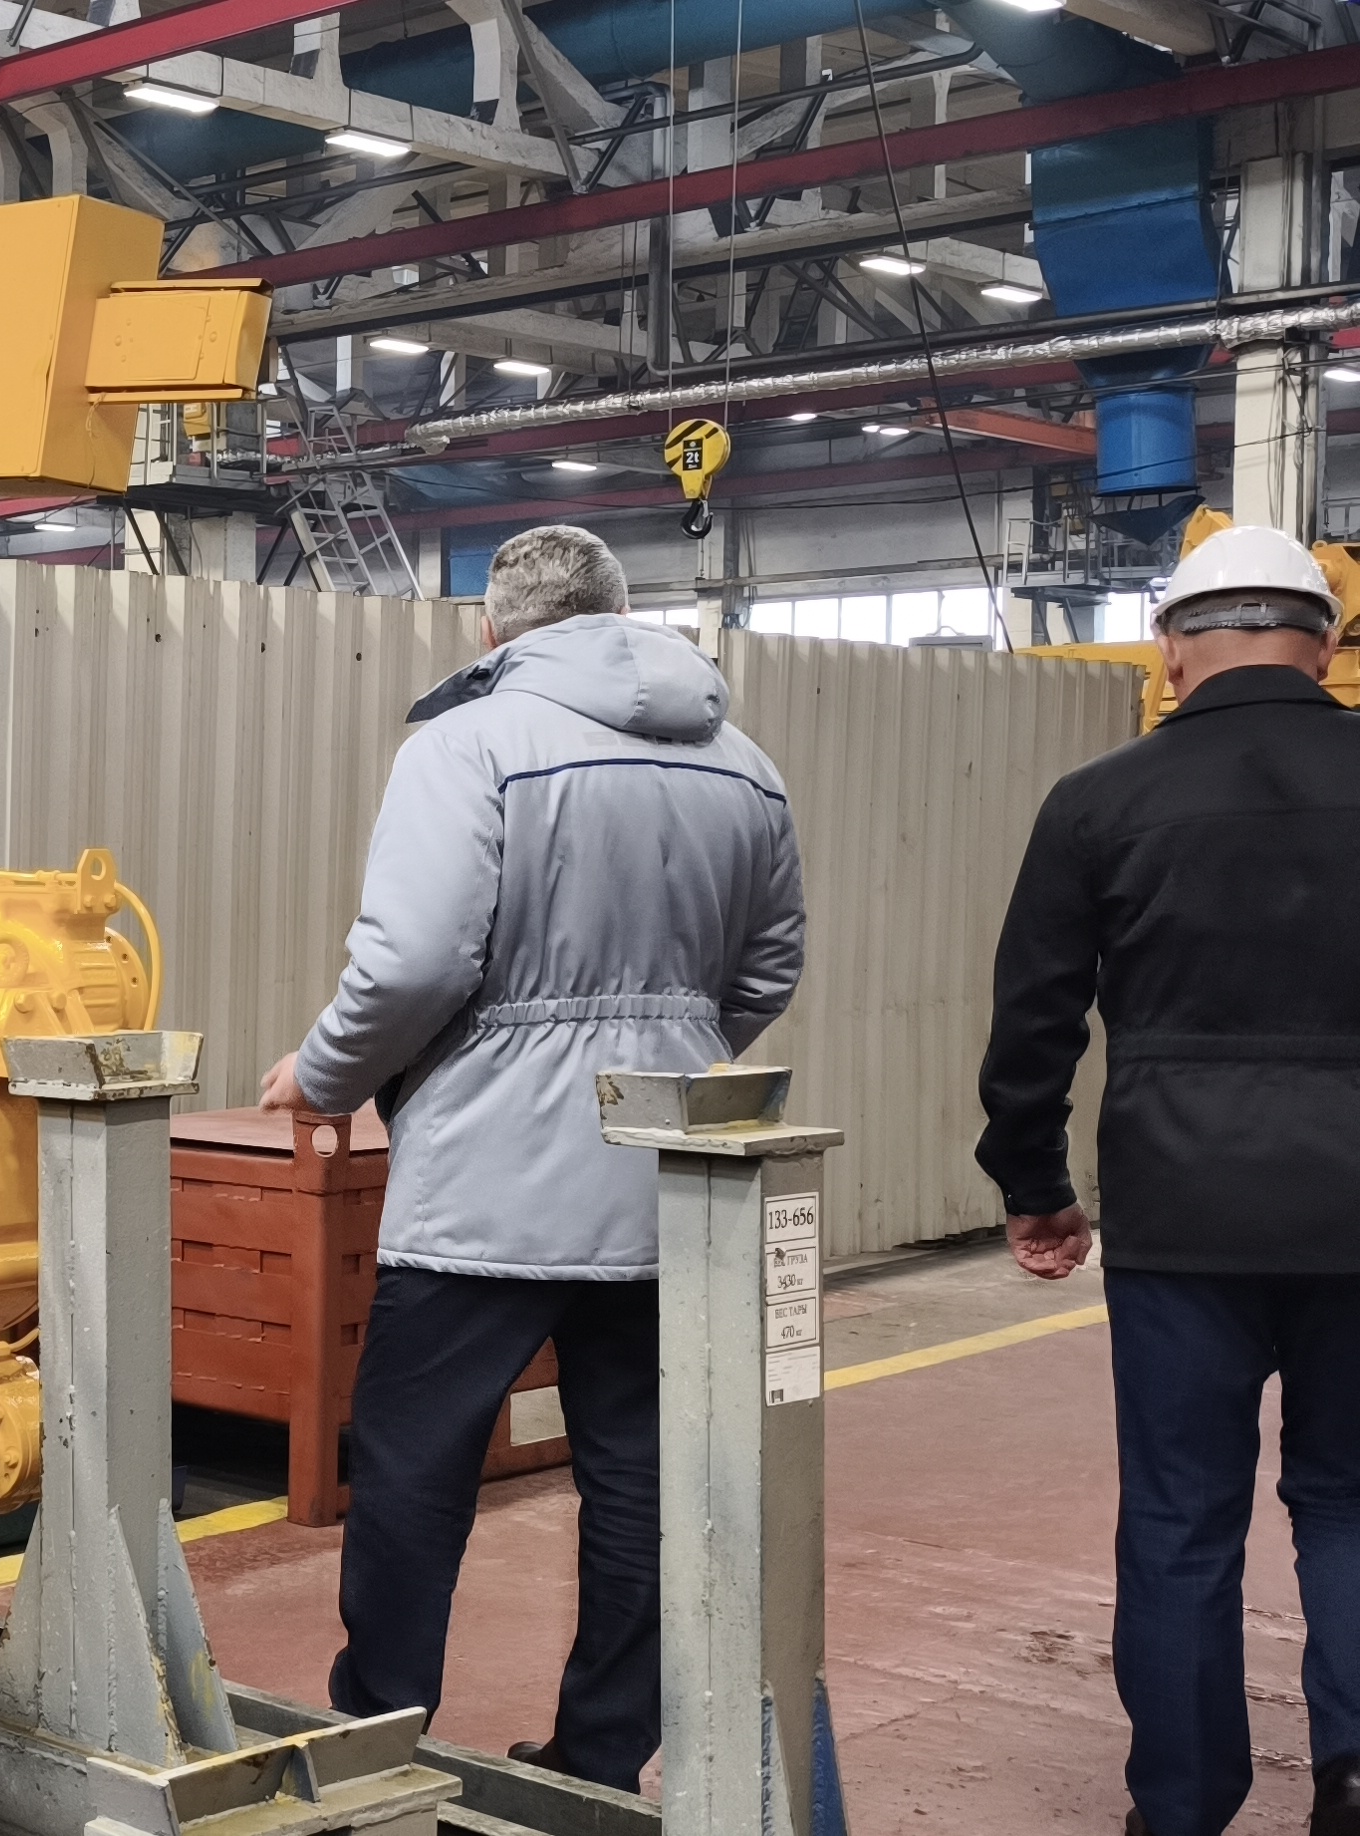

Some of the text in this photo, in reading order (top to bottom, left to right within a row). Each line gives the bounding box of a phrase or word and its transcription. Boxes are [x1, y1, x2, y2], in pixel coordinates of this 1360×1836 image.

[768, 1206, 814, 1229] 133-656
[774, 1303, 807, 1319] ВЕС ТАРЫ
